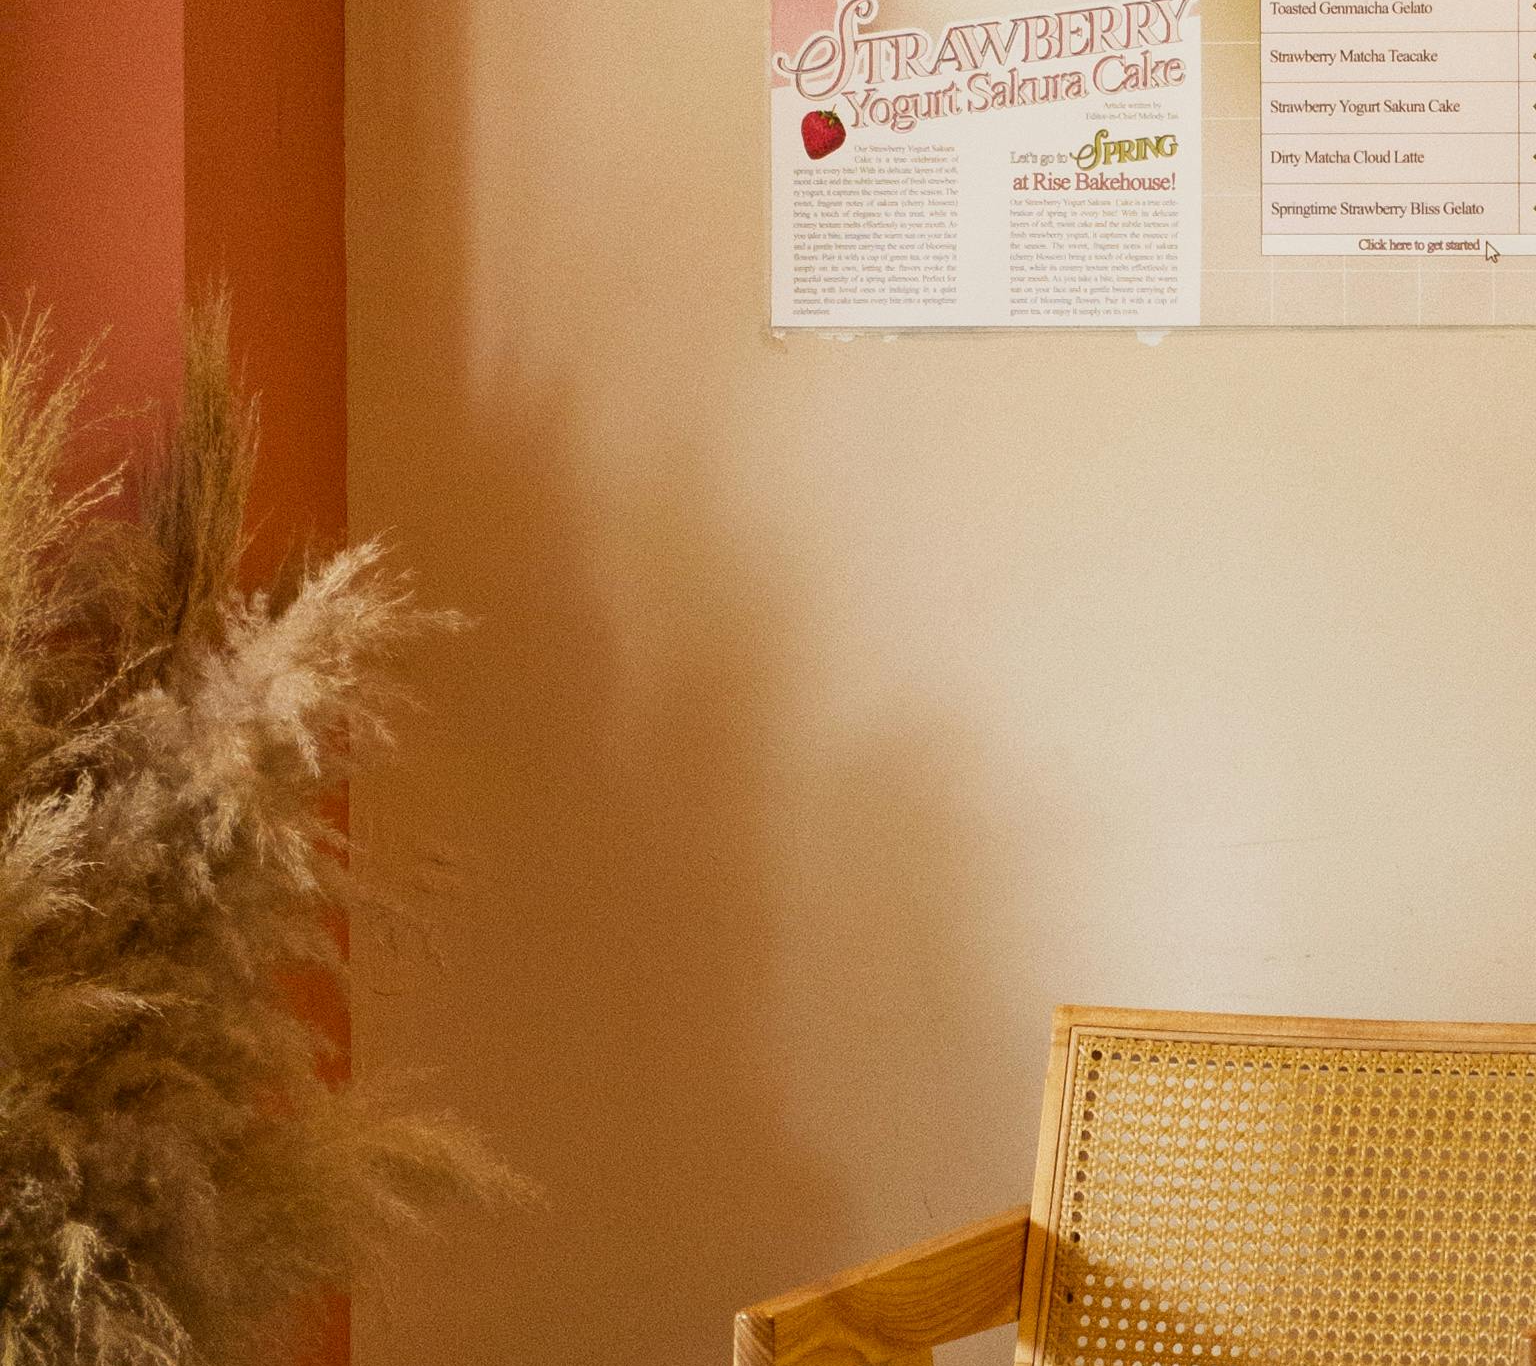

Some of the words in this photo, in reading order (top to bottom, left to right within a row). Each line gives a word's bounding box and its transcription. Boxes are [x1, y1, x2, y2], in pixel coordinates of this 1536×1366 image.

[1270, 1, 1316, 15] Toasted
[1319, 1, 1389, 15] Genmaicha
[1392, 1, 1432, 14] Gelato
[1270, 50, 1336, 66] Strawberry
[1340, 50, 1385, 63] Matcha
[1388, 49, 1438, 62] Teacake
[842, 82, 962, 133] Yogurt
[968, 68, 1089, 114] Sakura
[1093, 50, 1186, 95] Cake
[1270, 100, 1336, 116] Strawberry
[1339, 100, 1380, 116] Yogurt
[1384, 99, 1425, 113] Sakura
[1428, 99, 1460, 112] Cake
[1040, 153, 1053, 166] go
[1057, 151, 1068, 164] to
[1069, 129, 1178, 171] SPRING
[1270, 150, 1301, 167] Dirty
[1305, 150, 1350, 163] Matcha
[1353, 150, 1391, 163] Cloud
[1394, 150, 1425, 163] Latte
[1013, 174, 1028, 190] at
[1032, 172, 1071, 190] Rise
[1075, 171, 1176, 191] Bakehouse!
[1271, 202, 1337, 218] Springtime
[1340, 202, 1407, 218] Strawberry
[1410, 201, 1440, 215] Bliss
[1443, 201, 1484, 215] Gelato
[1358, 239, 1388, 251] Click
[1389, 239, 1412, 251] here
[1414, 240, 1425, 251] to
[1427, 240, 1443, 253] get
[1445, 238, 1480, 251] started
